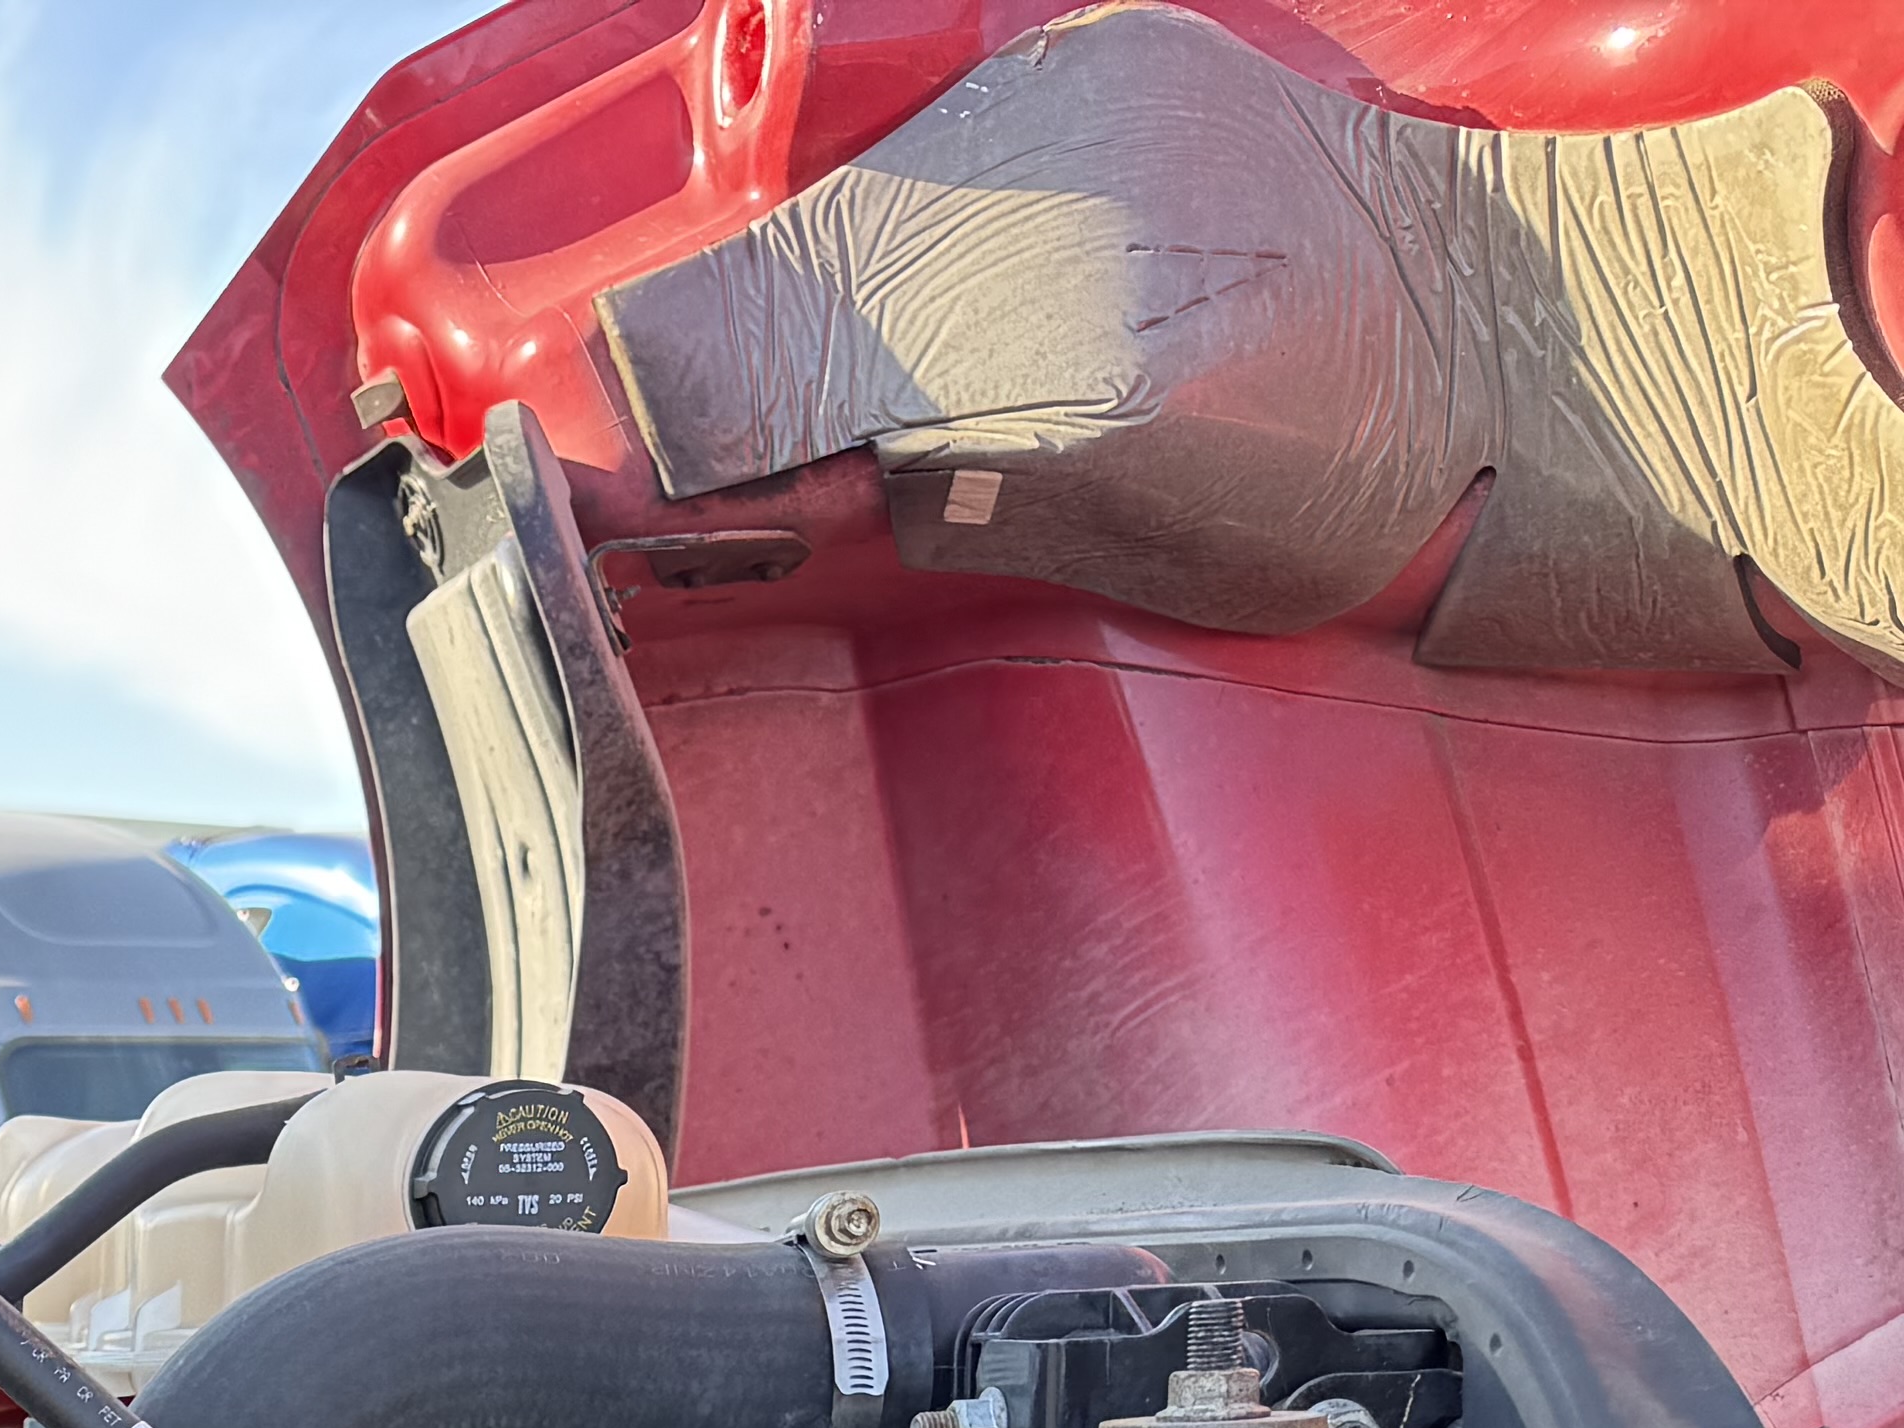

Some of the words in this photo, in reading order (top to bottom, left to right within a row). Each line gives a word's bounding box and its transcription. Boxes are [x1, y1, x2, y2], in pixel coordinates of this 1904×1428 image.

[509, 1104, 568, 1124] CAUTION
[492, 1121, 525, 1142] NEVER
[526, 1120, 555, 1133] OPEN
[554, 1125, 573, 1142] HOT
[500, 1142, 565, 1152] PRESSURIZED
[512, 1152, 552, 1163] SYSTEM
[466, 1196, 484, 1206] 140
[490, 1195, 508, 1205] kPa
[518, 1194, 539, 1214] TVS
[549, 1194, 563, 1204] 20
[567, 1193, 584, 1203] PSI
